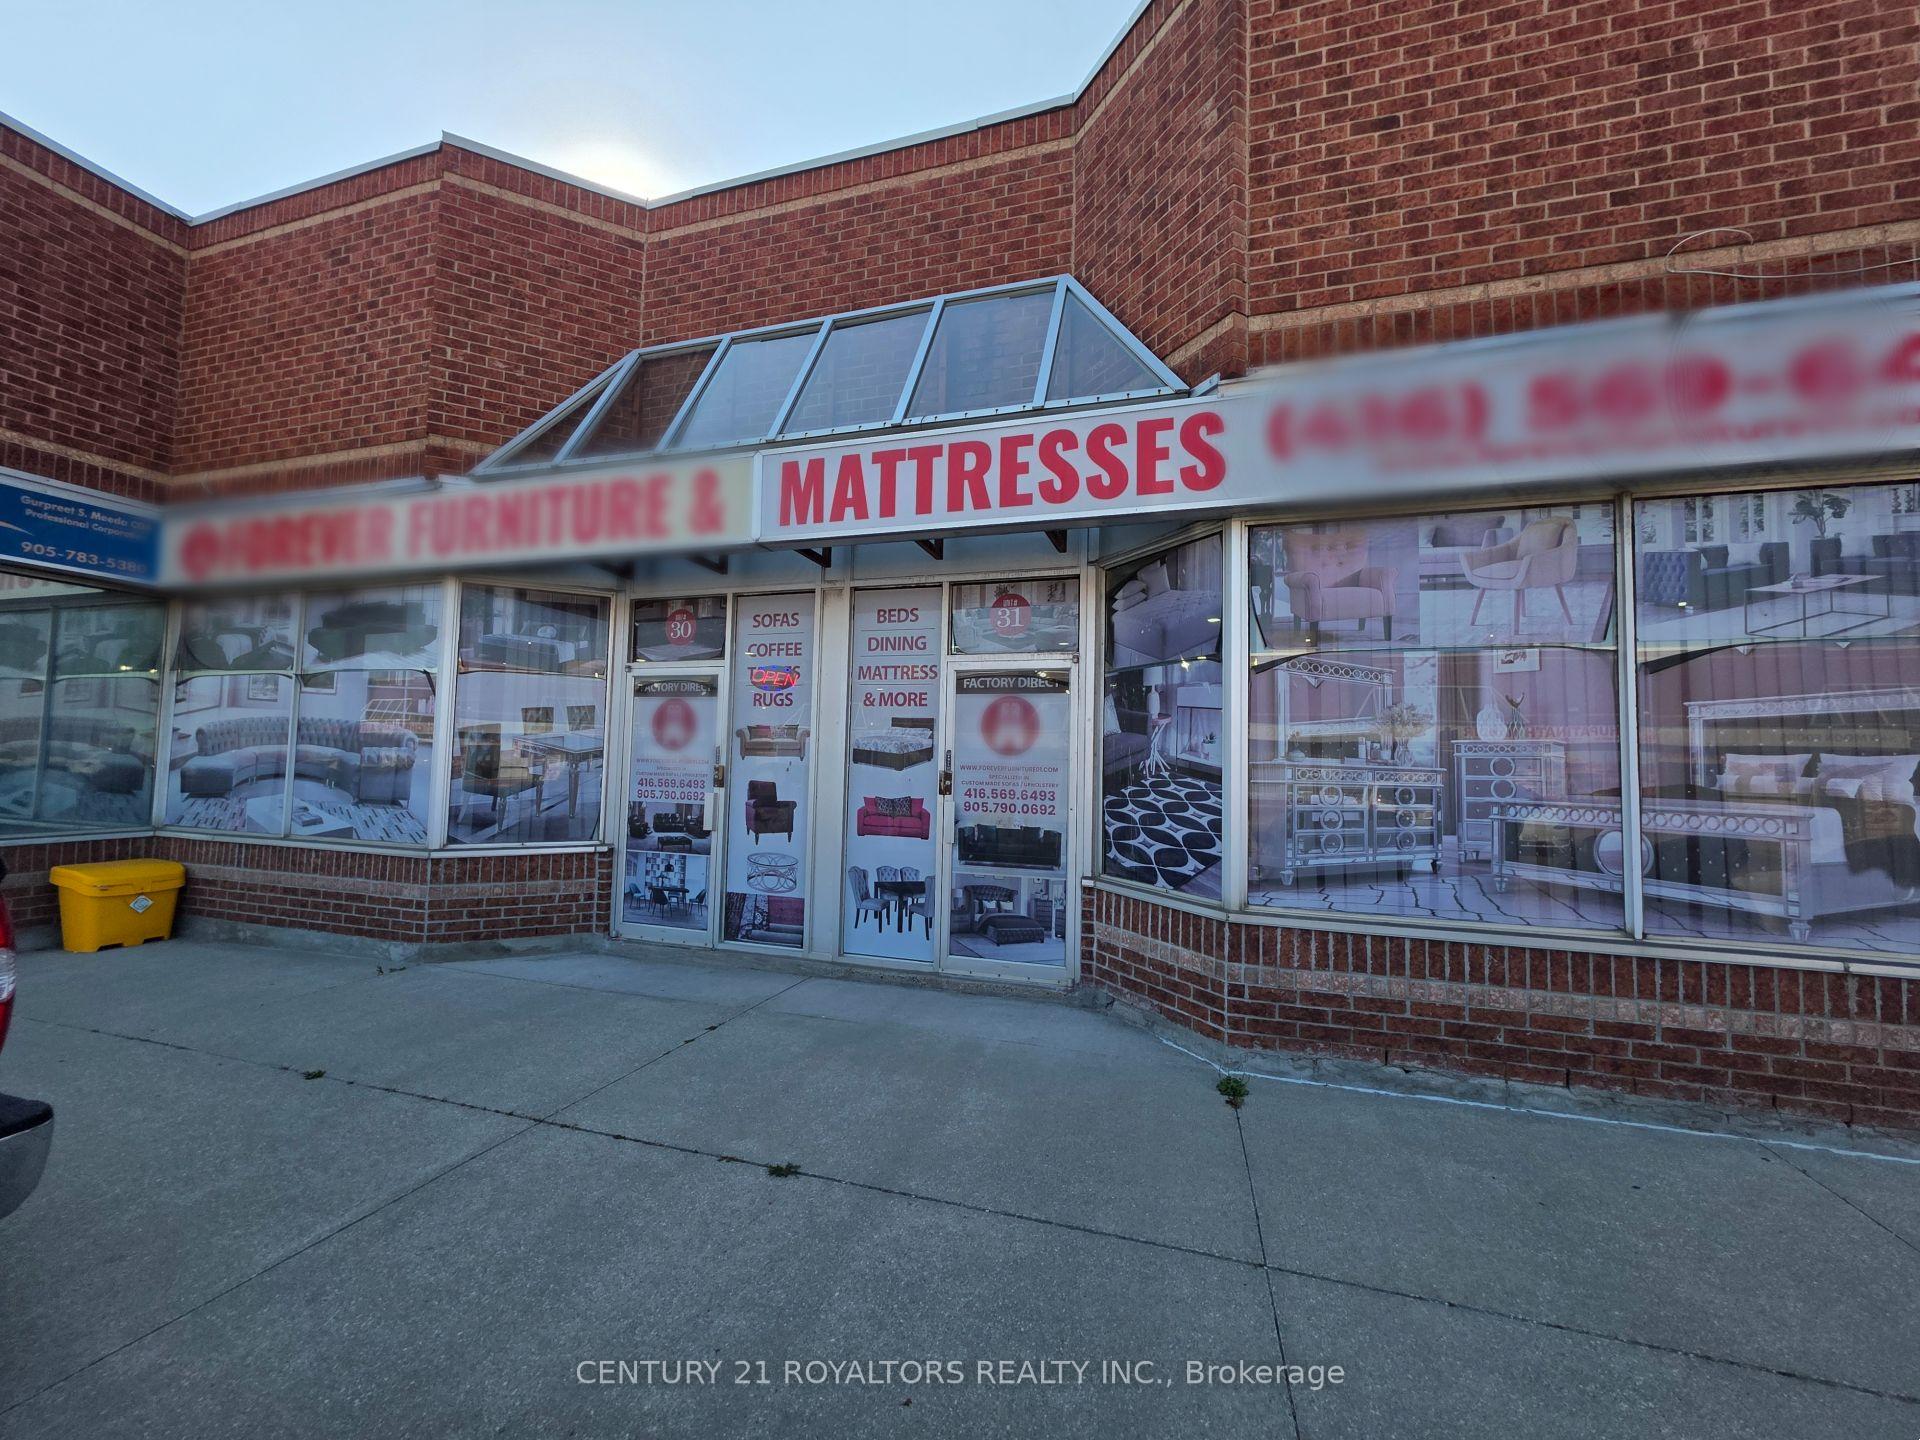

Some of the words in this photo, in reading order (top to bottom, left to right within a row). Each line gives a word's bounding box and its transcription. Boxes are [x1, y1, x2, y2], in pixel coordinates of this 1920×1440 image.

[779, 411, 1226, 527] MATTRESSES
[20, 495, 75, 514] Gurpreet
[78, 508, 88, 518] S.
[25, 509, 89, 529] Professional
[752, 612, 800, 628] SOFAS
[876, 608, 919, 624] BEDS
[996, 607, 1025, 628] 31
[670, 621, 692, 639] 30
[747, 642, 802, 657] COFFEE
[867, 636, 927, 652] DINING
[752, 669, 798, 688] OPEN
[858, 664, 938, 680] MATTRESS
[963, 677, 1016, 689] FACTORY
[753, 693, 793, 707] RUGS
[863, 692, 876, 707] &
[879, 692, 928, 707] MORE
[637, 777, 706, 789] 416.569.6493
[636, 789, 706, 801] 905.790.0692
[963, 787, 1056, 801] 416.569.6493
[963, 801, 1056, 816] 905.790.0692
